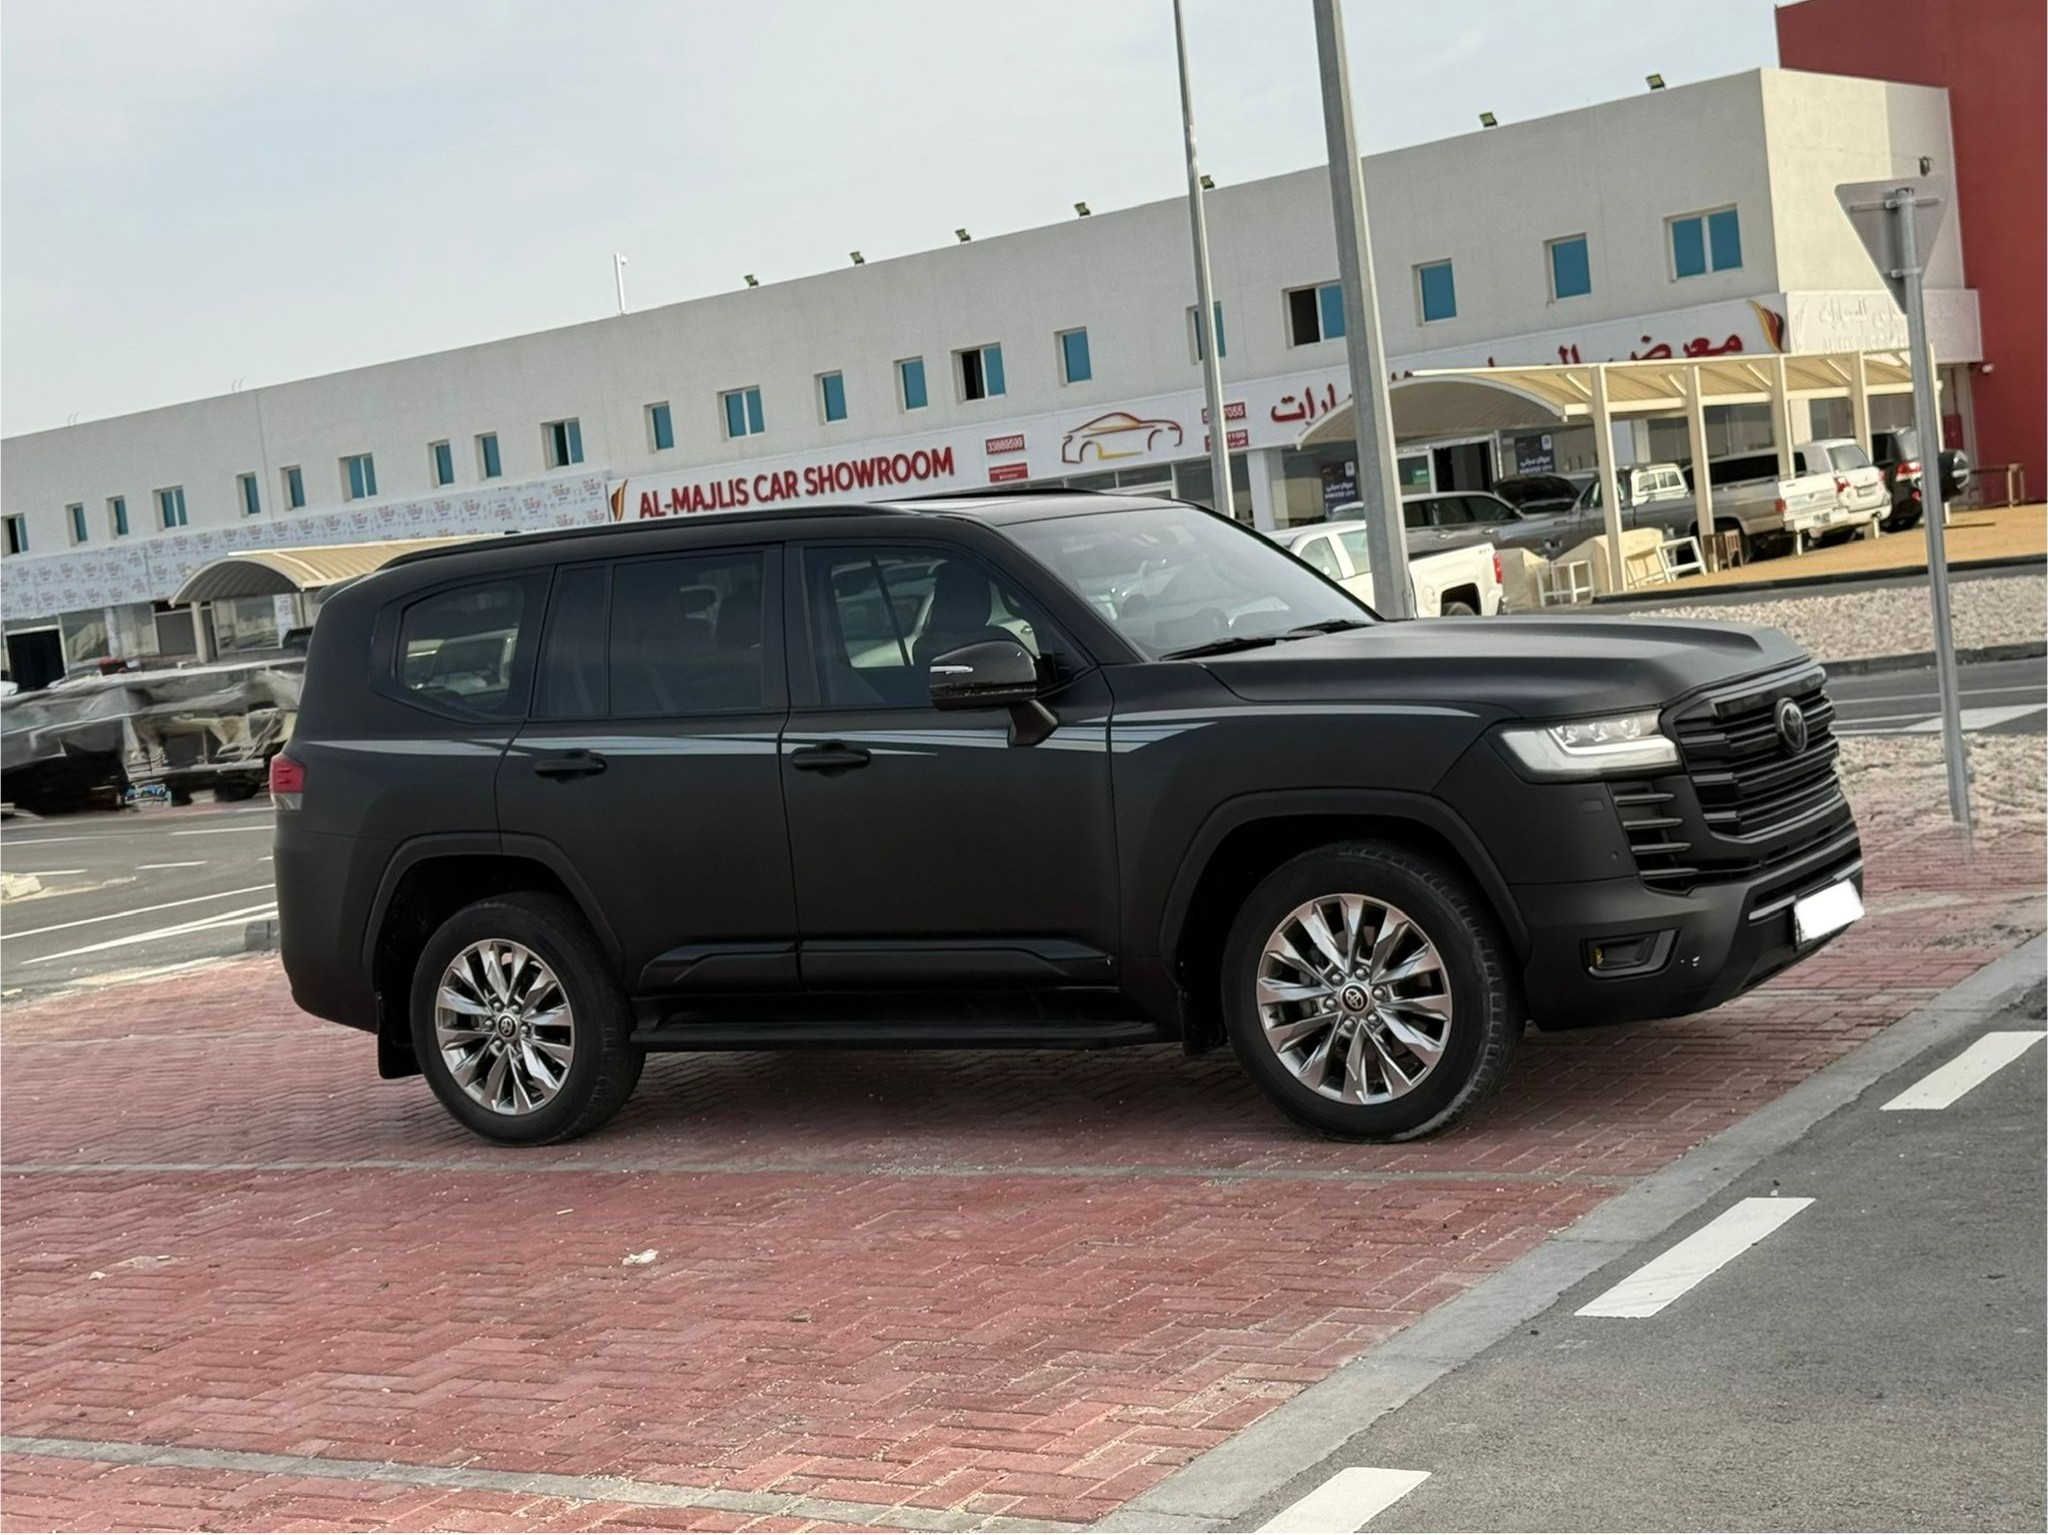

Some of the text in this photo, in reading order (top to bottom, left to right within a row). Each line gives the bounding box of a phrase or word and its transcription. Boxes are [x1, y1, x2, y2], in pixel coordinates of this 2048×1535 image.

[639, 478, 750, 520] AL-MAJLIS
[753, 468, 800, 503] CAR
[804, 446, 955, 496] SHOWROOM
